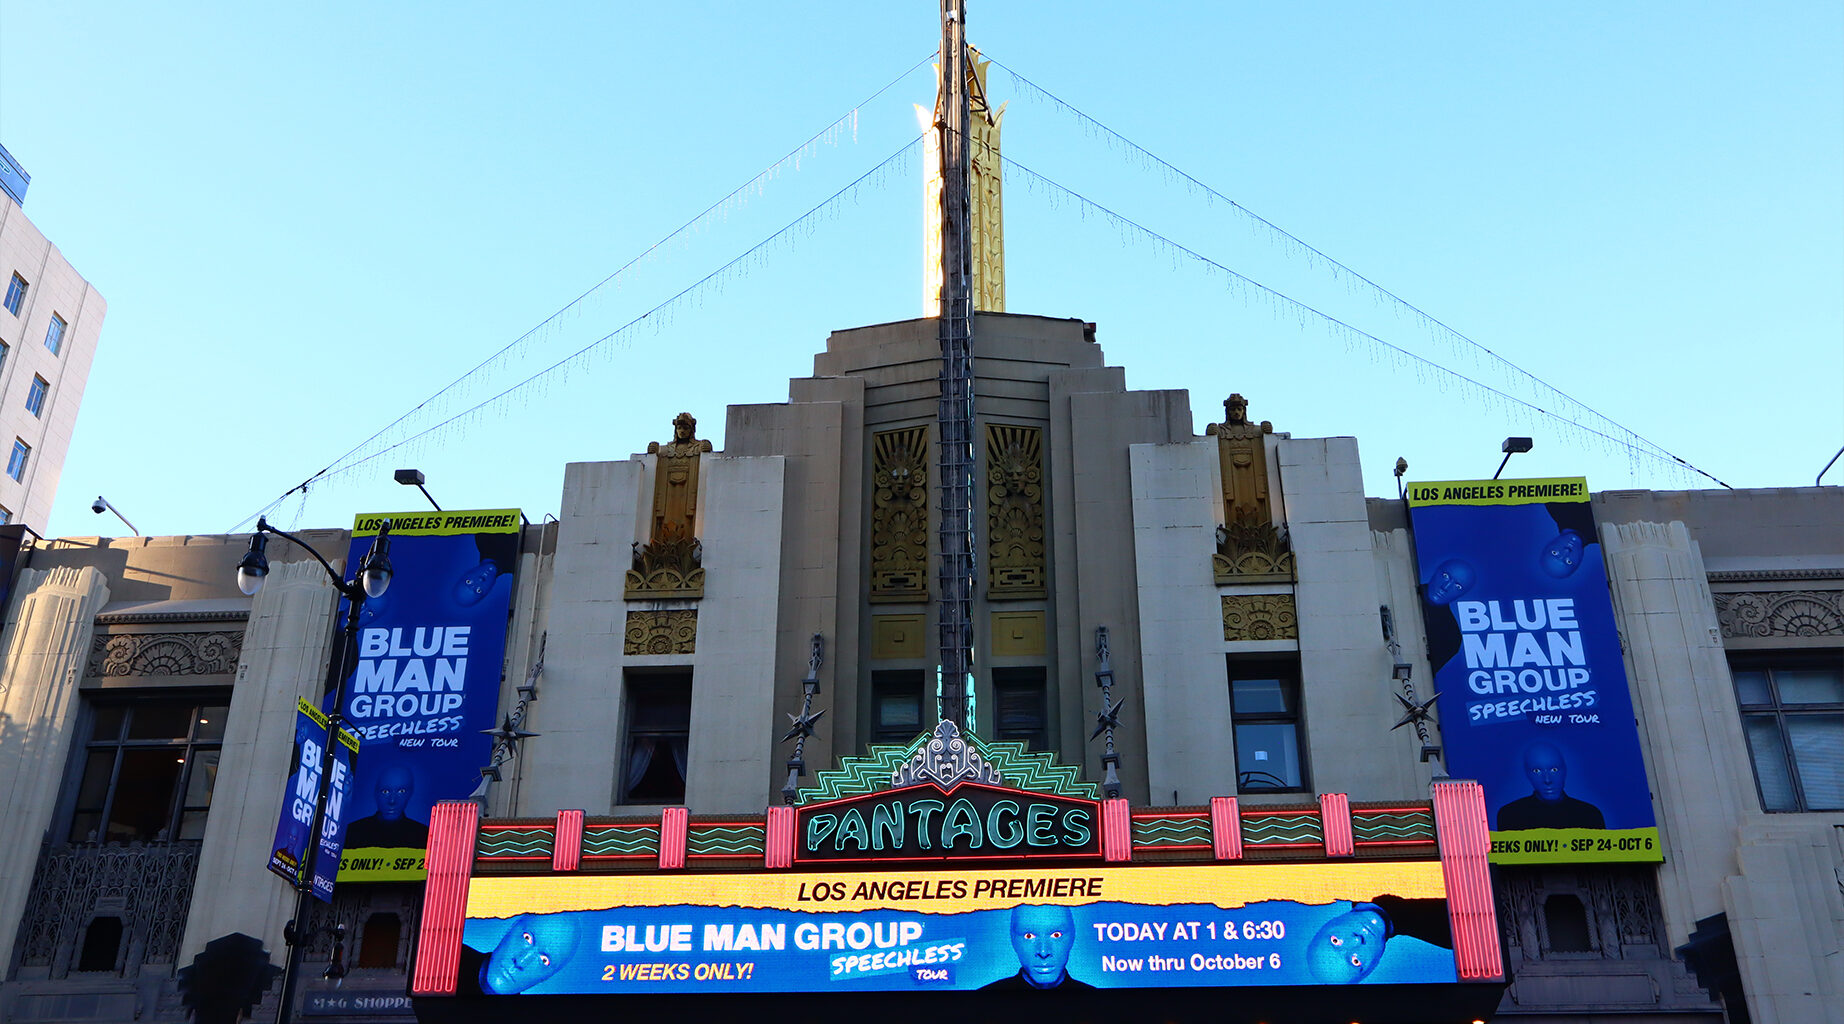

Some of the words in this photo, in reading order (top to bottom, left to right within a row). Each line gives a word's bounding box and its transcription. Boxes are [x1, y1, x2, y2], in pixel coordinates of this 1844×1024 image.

[1414, 488, 1439, 500] LOS
[1443, 486, 1504, 500] ANGELES
[1509, 483, 1582, 498] PREMIERE!
[357, 519, 385, 531] LOS
[444, 515, 515, 529] PREMIERE!
[1457, 598, 1579, 631] BLUE
[360, 626, 471, 657] BLUE
[1462, 631, 1586, 668] MAN
[354, 658, 467, 692] MAN
[1468, 668, 1590, 695] GROUP
[350, 694, 463, 718] GROUP
[1469, 690, 1596, 721] SPEECHLESS
[1535, 715, 1562, 724] NEW
[1569, 714, 1600, 724] TOUR
[399, 738, 425, 748] NEW
[431, 738, 459, 748] TOUR
[293, 798, 338, 839] GRUP
[807, 798, 1091, 851] PANTAGES
[1491, 841, 1520, 853] EEKS
[1524, 840, 1559, 853] ONLY!
[1571, 839, 1594, 851] SEP
[1597, 838, 1642, 851] 24-OCT
[1645, 838, 1653, 850] 6
[350, 858, 384, 871] ONLY!
[393, 858, 415, 870] SEP
[797, 882, 847, 902] LOS
[851, 880, 967, 900] ANGELES
[973, 877, 1104, 899] PREMIERE
[601, 925, 692, 952] BLUE
[703, 924, 786, 951] MAN
[794, 922, 923, 950] GROUP
[1093, 922, 1168, 942] TODAY
[1173, 922, 1201, 940] AT
[1206, 922, 1216, 940] 1
[1223, 921, 1239, 940] &
[1242, 921, 1285, 940] 6:30
[832, 943, 965, 975] SPEECHLESS
[1102, 955, 1143, 972] Now
[1148, 955, 1185, 971] thru
[1190, 953, 1265, 971] October
[1269, 953, 1281, 970] 6
[602, 965, 615, 980] 2
[620, 964, 690, 980] WEEKS
[694, 963, 754, 980] ONLY!
[916, 969, 948, 980] TOUR
